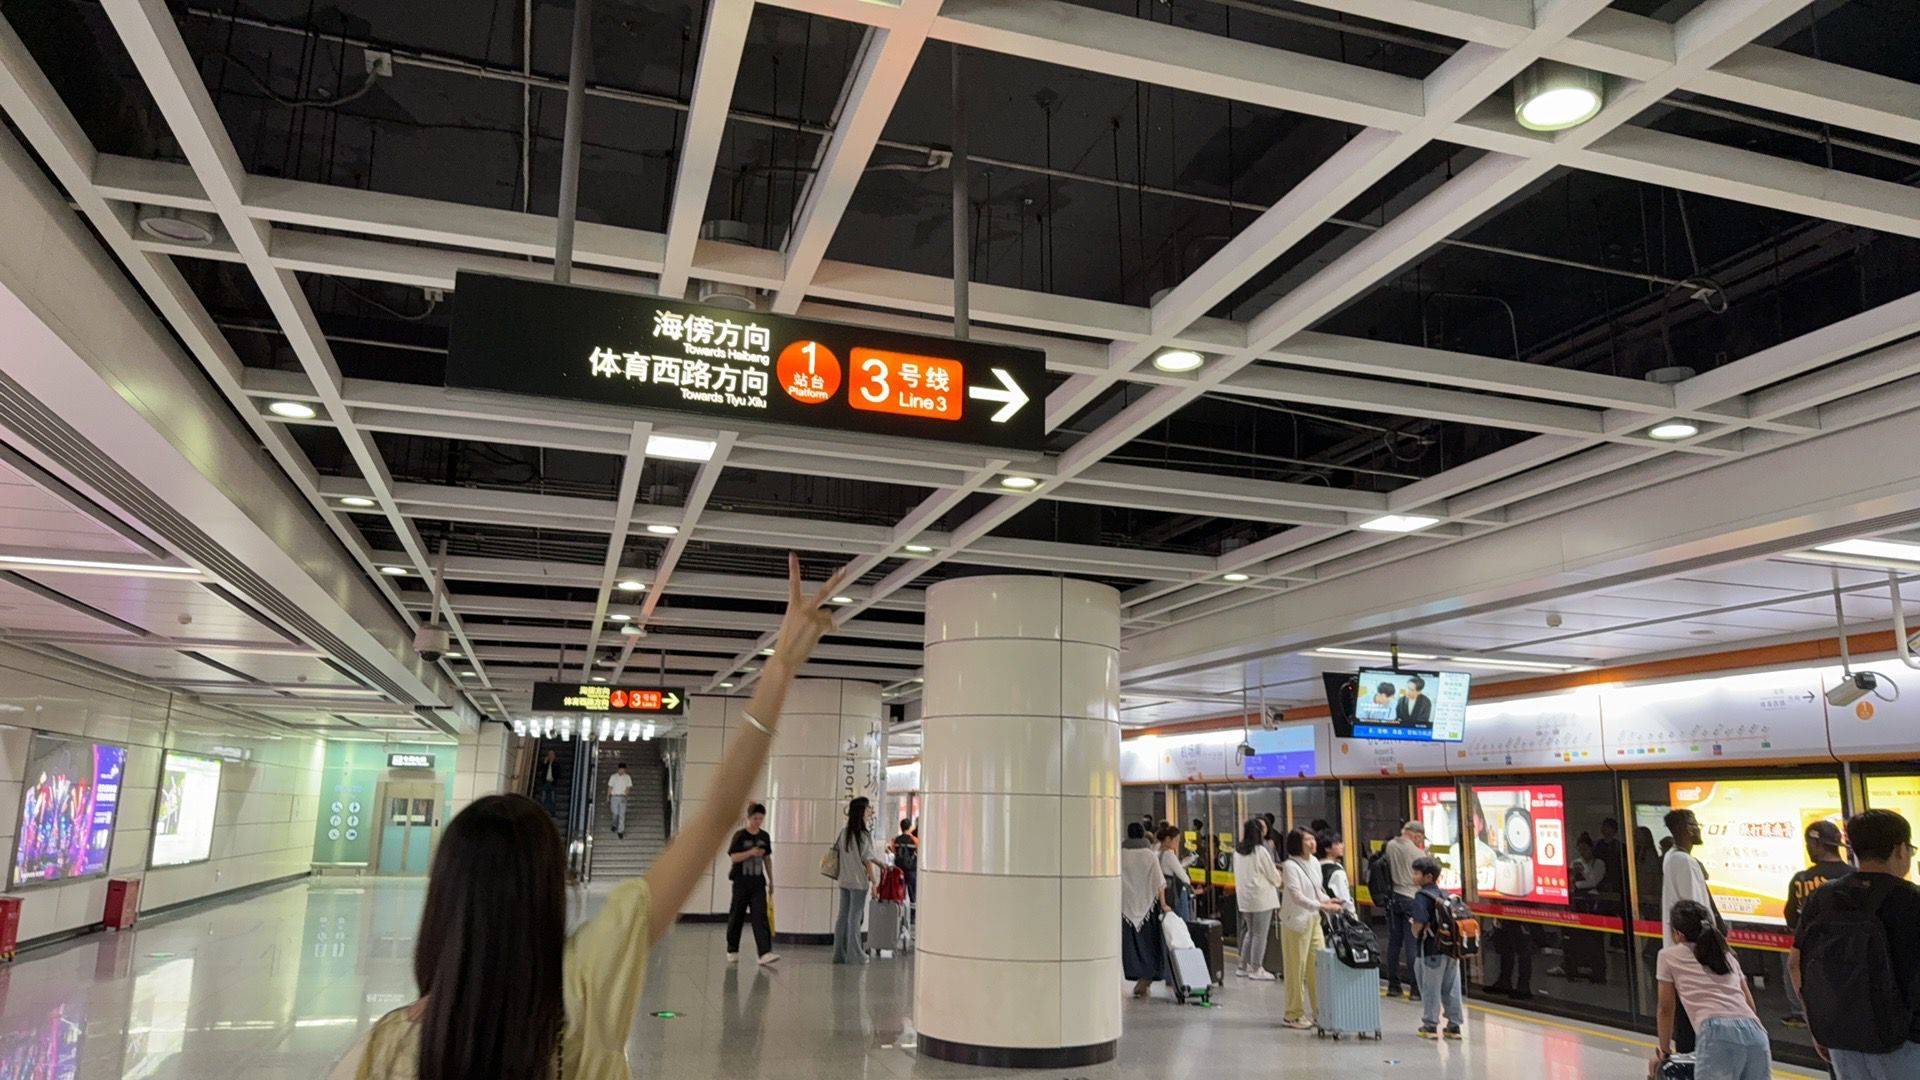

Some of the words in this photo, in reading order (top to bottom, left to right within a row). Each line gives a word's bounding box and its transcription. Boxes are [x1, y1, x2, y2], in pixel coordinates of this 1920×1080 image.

[652, 309, 770, 352] 海傍方向
[683, 342, 727, 359] Towards
[728, 348, 770, 366] Haibang
[801, 341, 816, 375] 1
[588, 346, 769, 396] 体育西路方向
[793, 372, 825, 390] 站台
[860, 358, 890, 403] 3
[898, 363, 950, 393] 号线
[680, 388, 724, 404] Towards
[725, 395, 747, 408] Tiyu
[788, 386, 829, 400] Platform
[899, 391, 935, 410] Line
[936, 395, 948, 412] 3
[632, 693, 641, 707] 3
[843, 739, 858, 800] Airport
